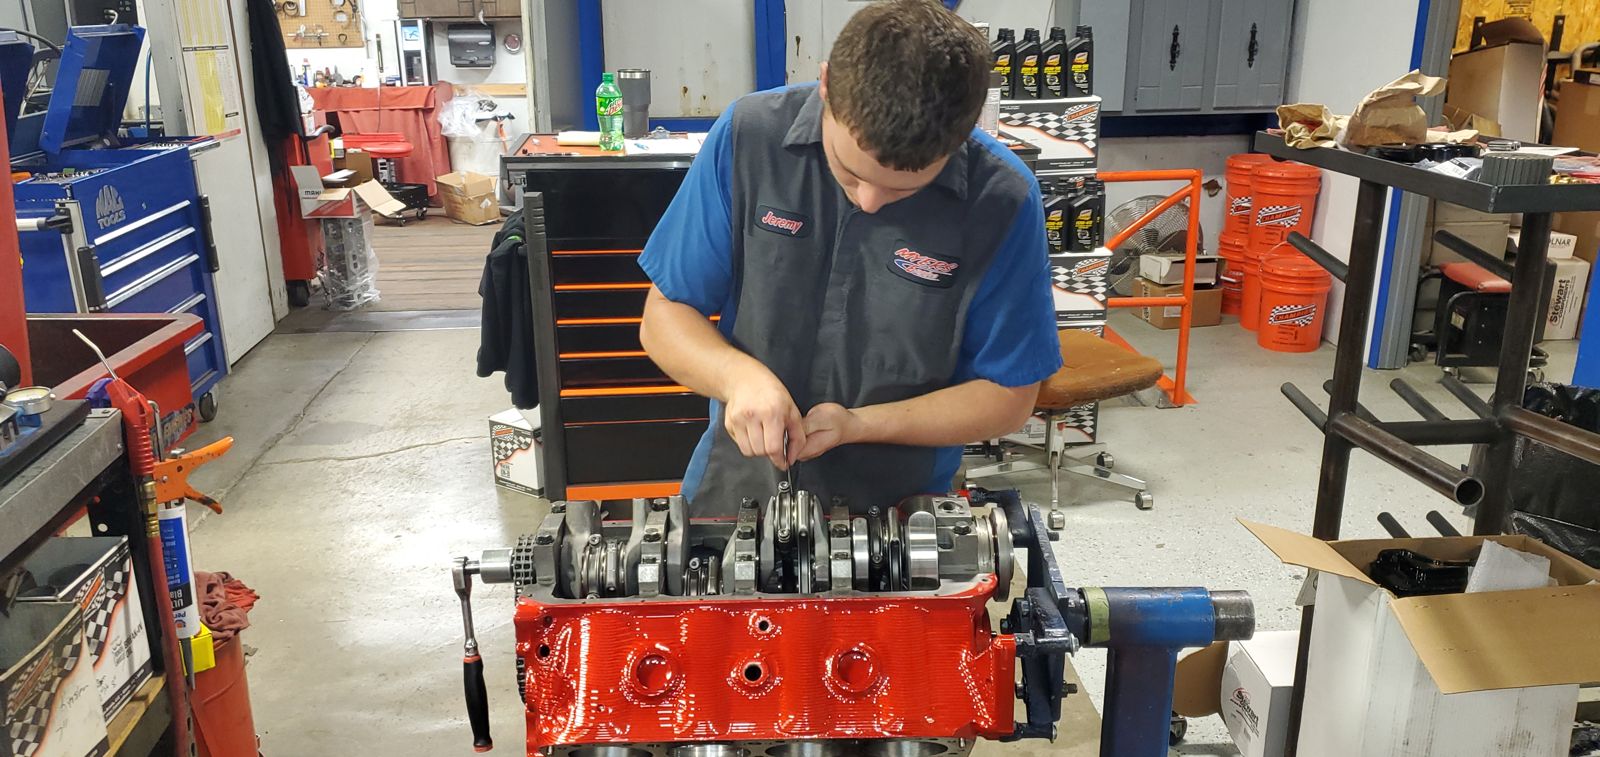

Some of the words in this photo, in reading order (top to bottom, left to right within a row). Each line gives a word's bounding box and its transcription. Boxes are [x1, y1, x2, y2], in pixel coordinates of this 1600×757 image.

[98, 210, 126, 229] TOOLS
[762, 211, 803, 234] Jeremy
[1549, 279, 1567, 323] Stewart
[169, 589, 183, 598] Bla
[171, 598, 184, 608] ULT
